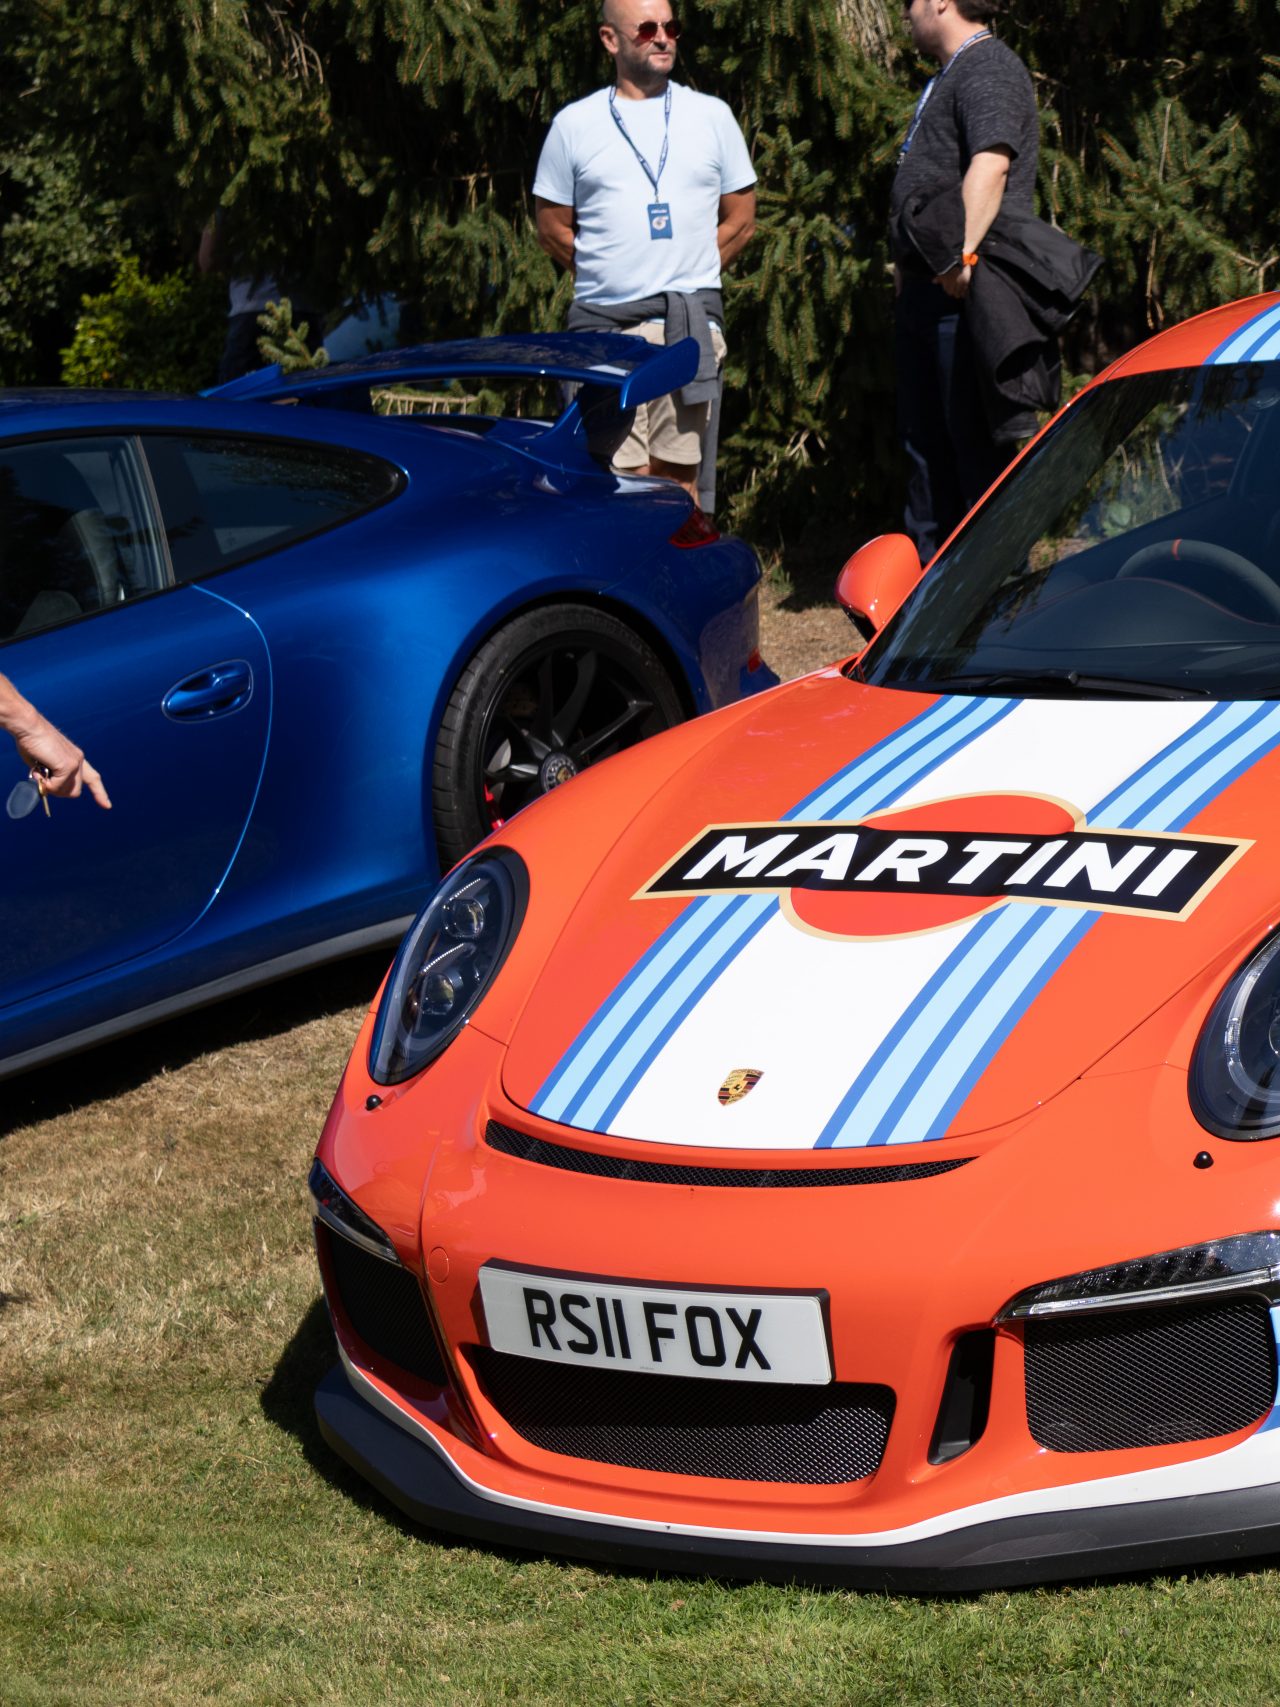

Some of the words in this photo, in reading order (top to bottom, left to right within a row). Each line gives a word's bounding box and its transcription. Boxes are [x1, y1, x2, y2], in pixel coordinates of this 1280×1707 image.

[682, 834, 1198, 897] MARTINI
[523, 1287, 631, 1359] RS11
[642, 1301, 772, 1370] FOX
